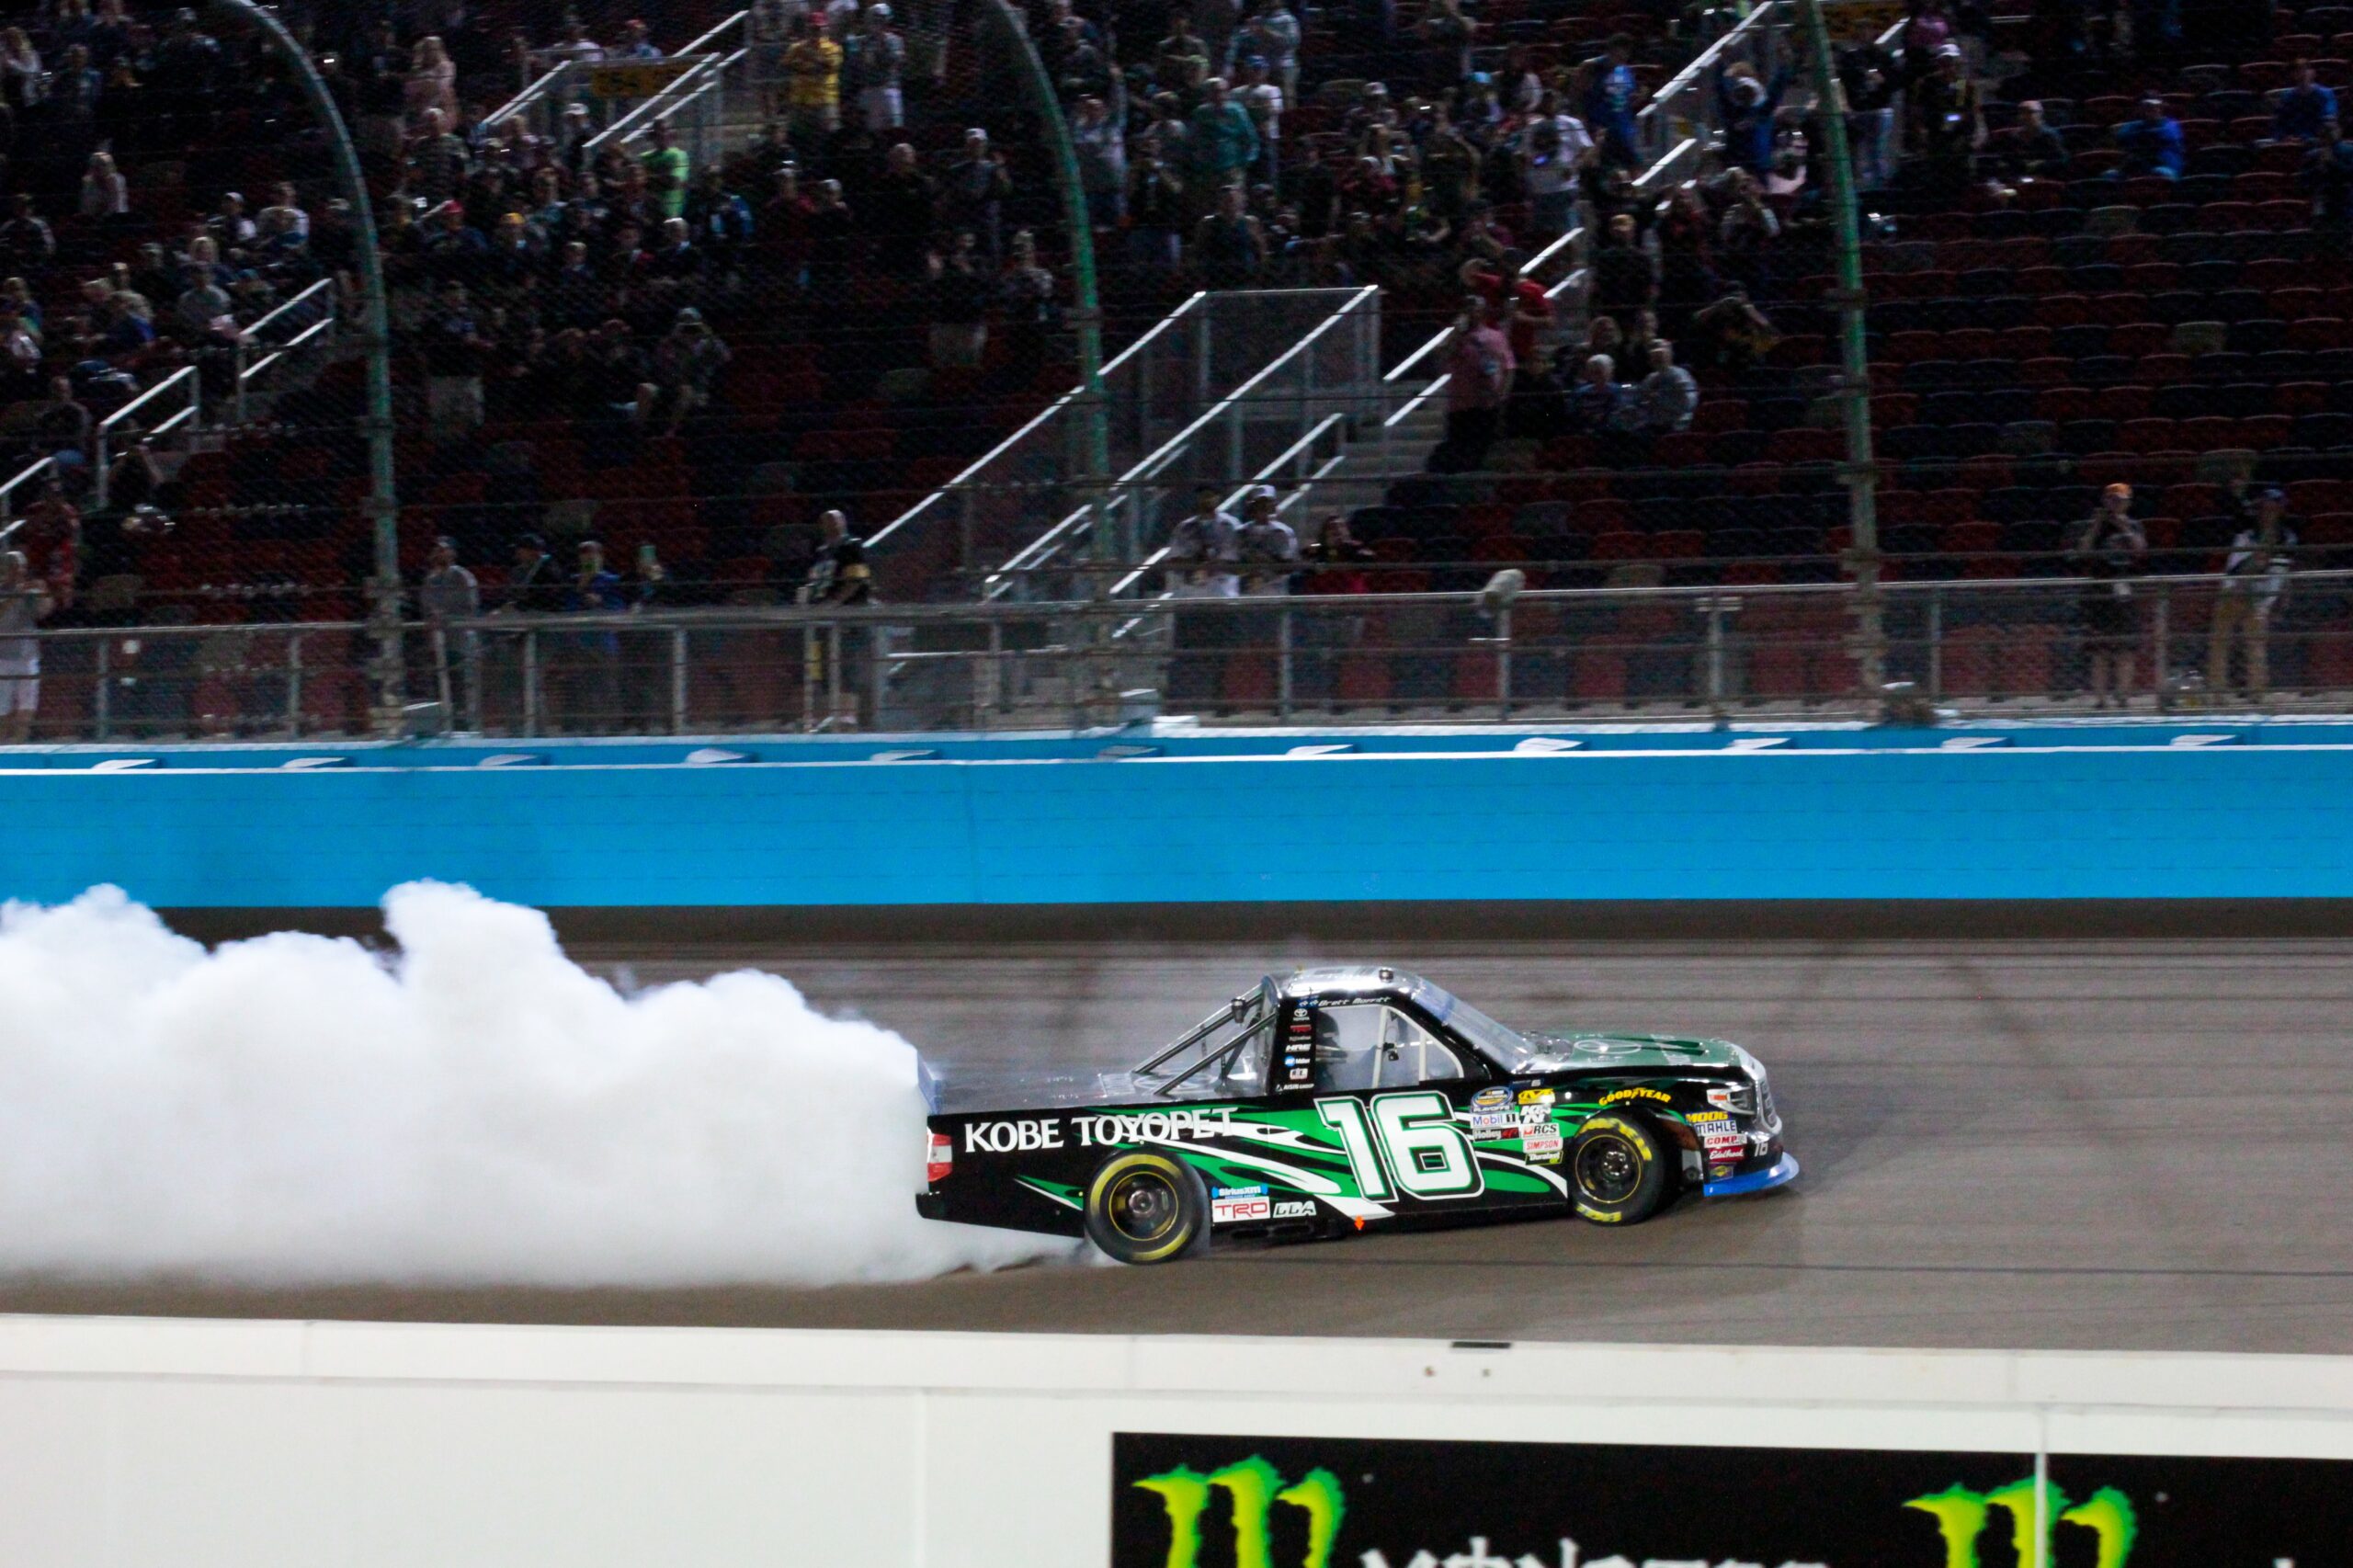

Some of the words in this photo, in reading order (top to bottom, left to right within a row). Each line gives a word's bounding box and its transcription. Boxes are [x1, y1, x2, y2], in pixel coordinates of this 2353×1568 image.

[1598, 1086, 1672, 1106] GOODYEAR
[1472, 1115, 1504, 1127] Mobil
[1686, 1110, 1729, 1123] MOOG
[964, 1118, 1064, 1153] KOBE
[1071, 1107, 1239, 1147] TOYOPET
[1533, 1123, 1558, 1135] RCS
[1695, 1121, 1736, 1133] MAHLE
[1526, 1140, 1560, 1151] SIMPSON
[1707, 1135, 1737, 1146] COMP
[1313, 1091, 1485, 1203] 16
[1214, 1201, 1268, 1219] TRD
